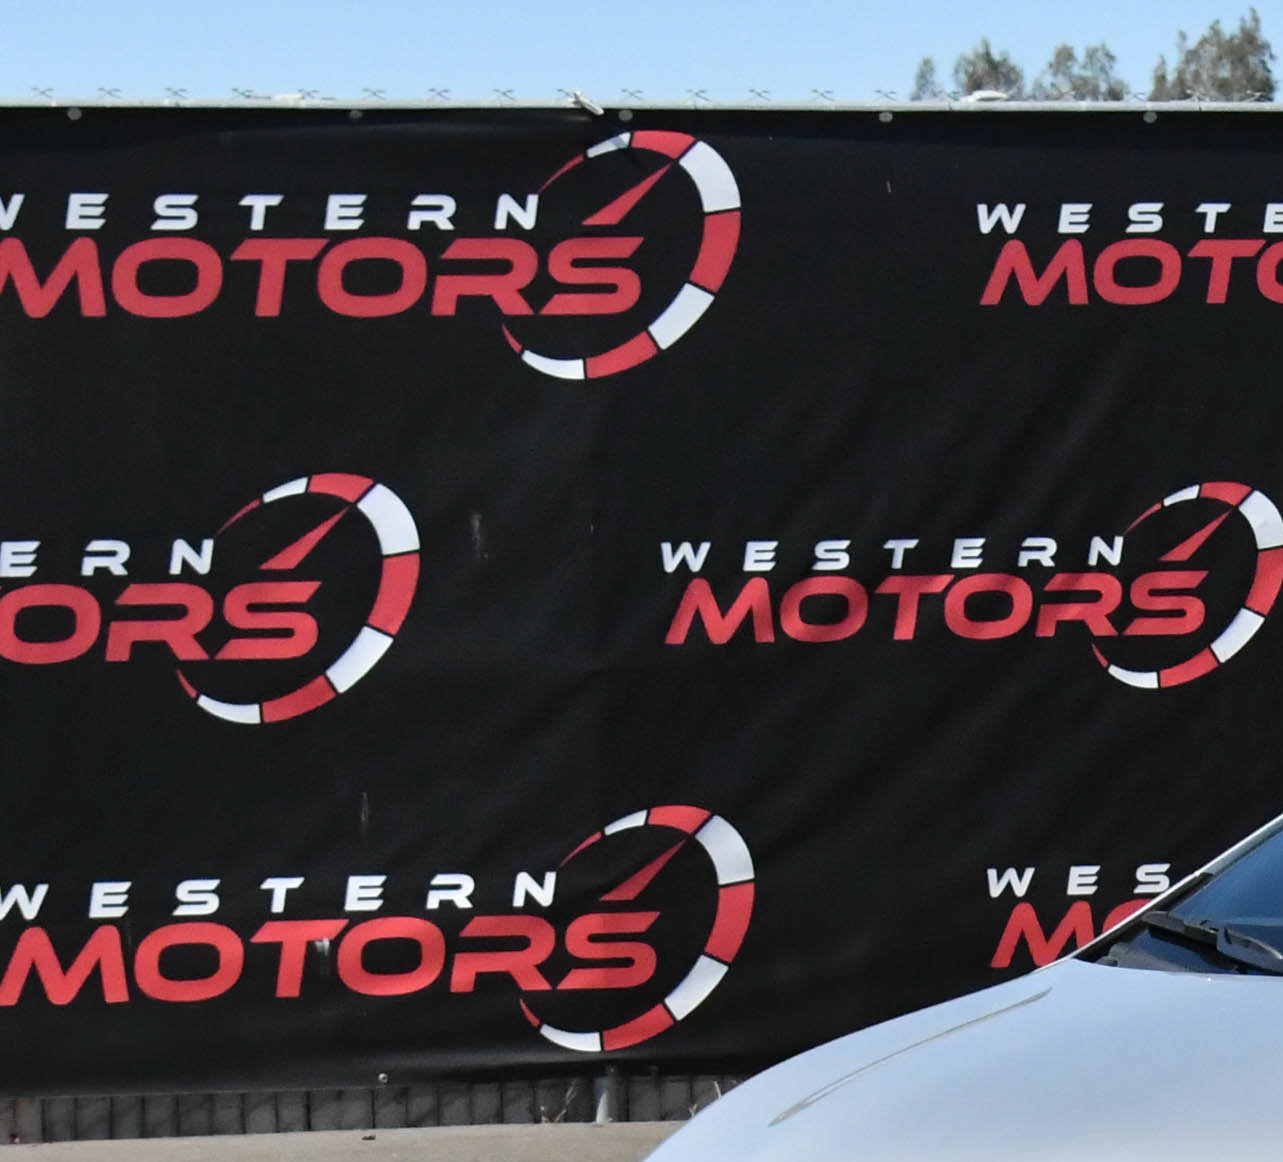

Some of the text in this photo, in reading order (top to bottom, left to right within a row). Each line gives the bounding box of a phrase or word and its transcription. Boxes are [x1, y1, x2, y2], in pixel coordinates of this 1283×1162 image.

[662, 536, 1123, 572] WESTERN
[666, 571, 1208, 644] MOTORS
[0, 872, 557, 921] WESTERN
[0, 911, 661, 1008] MOTORS
